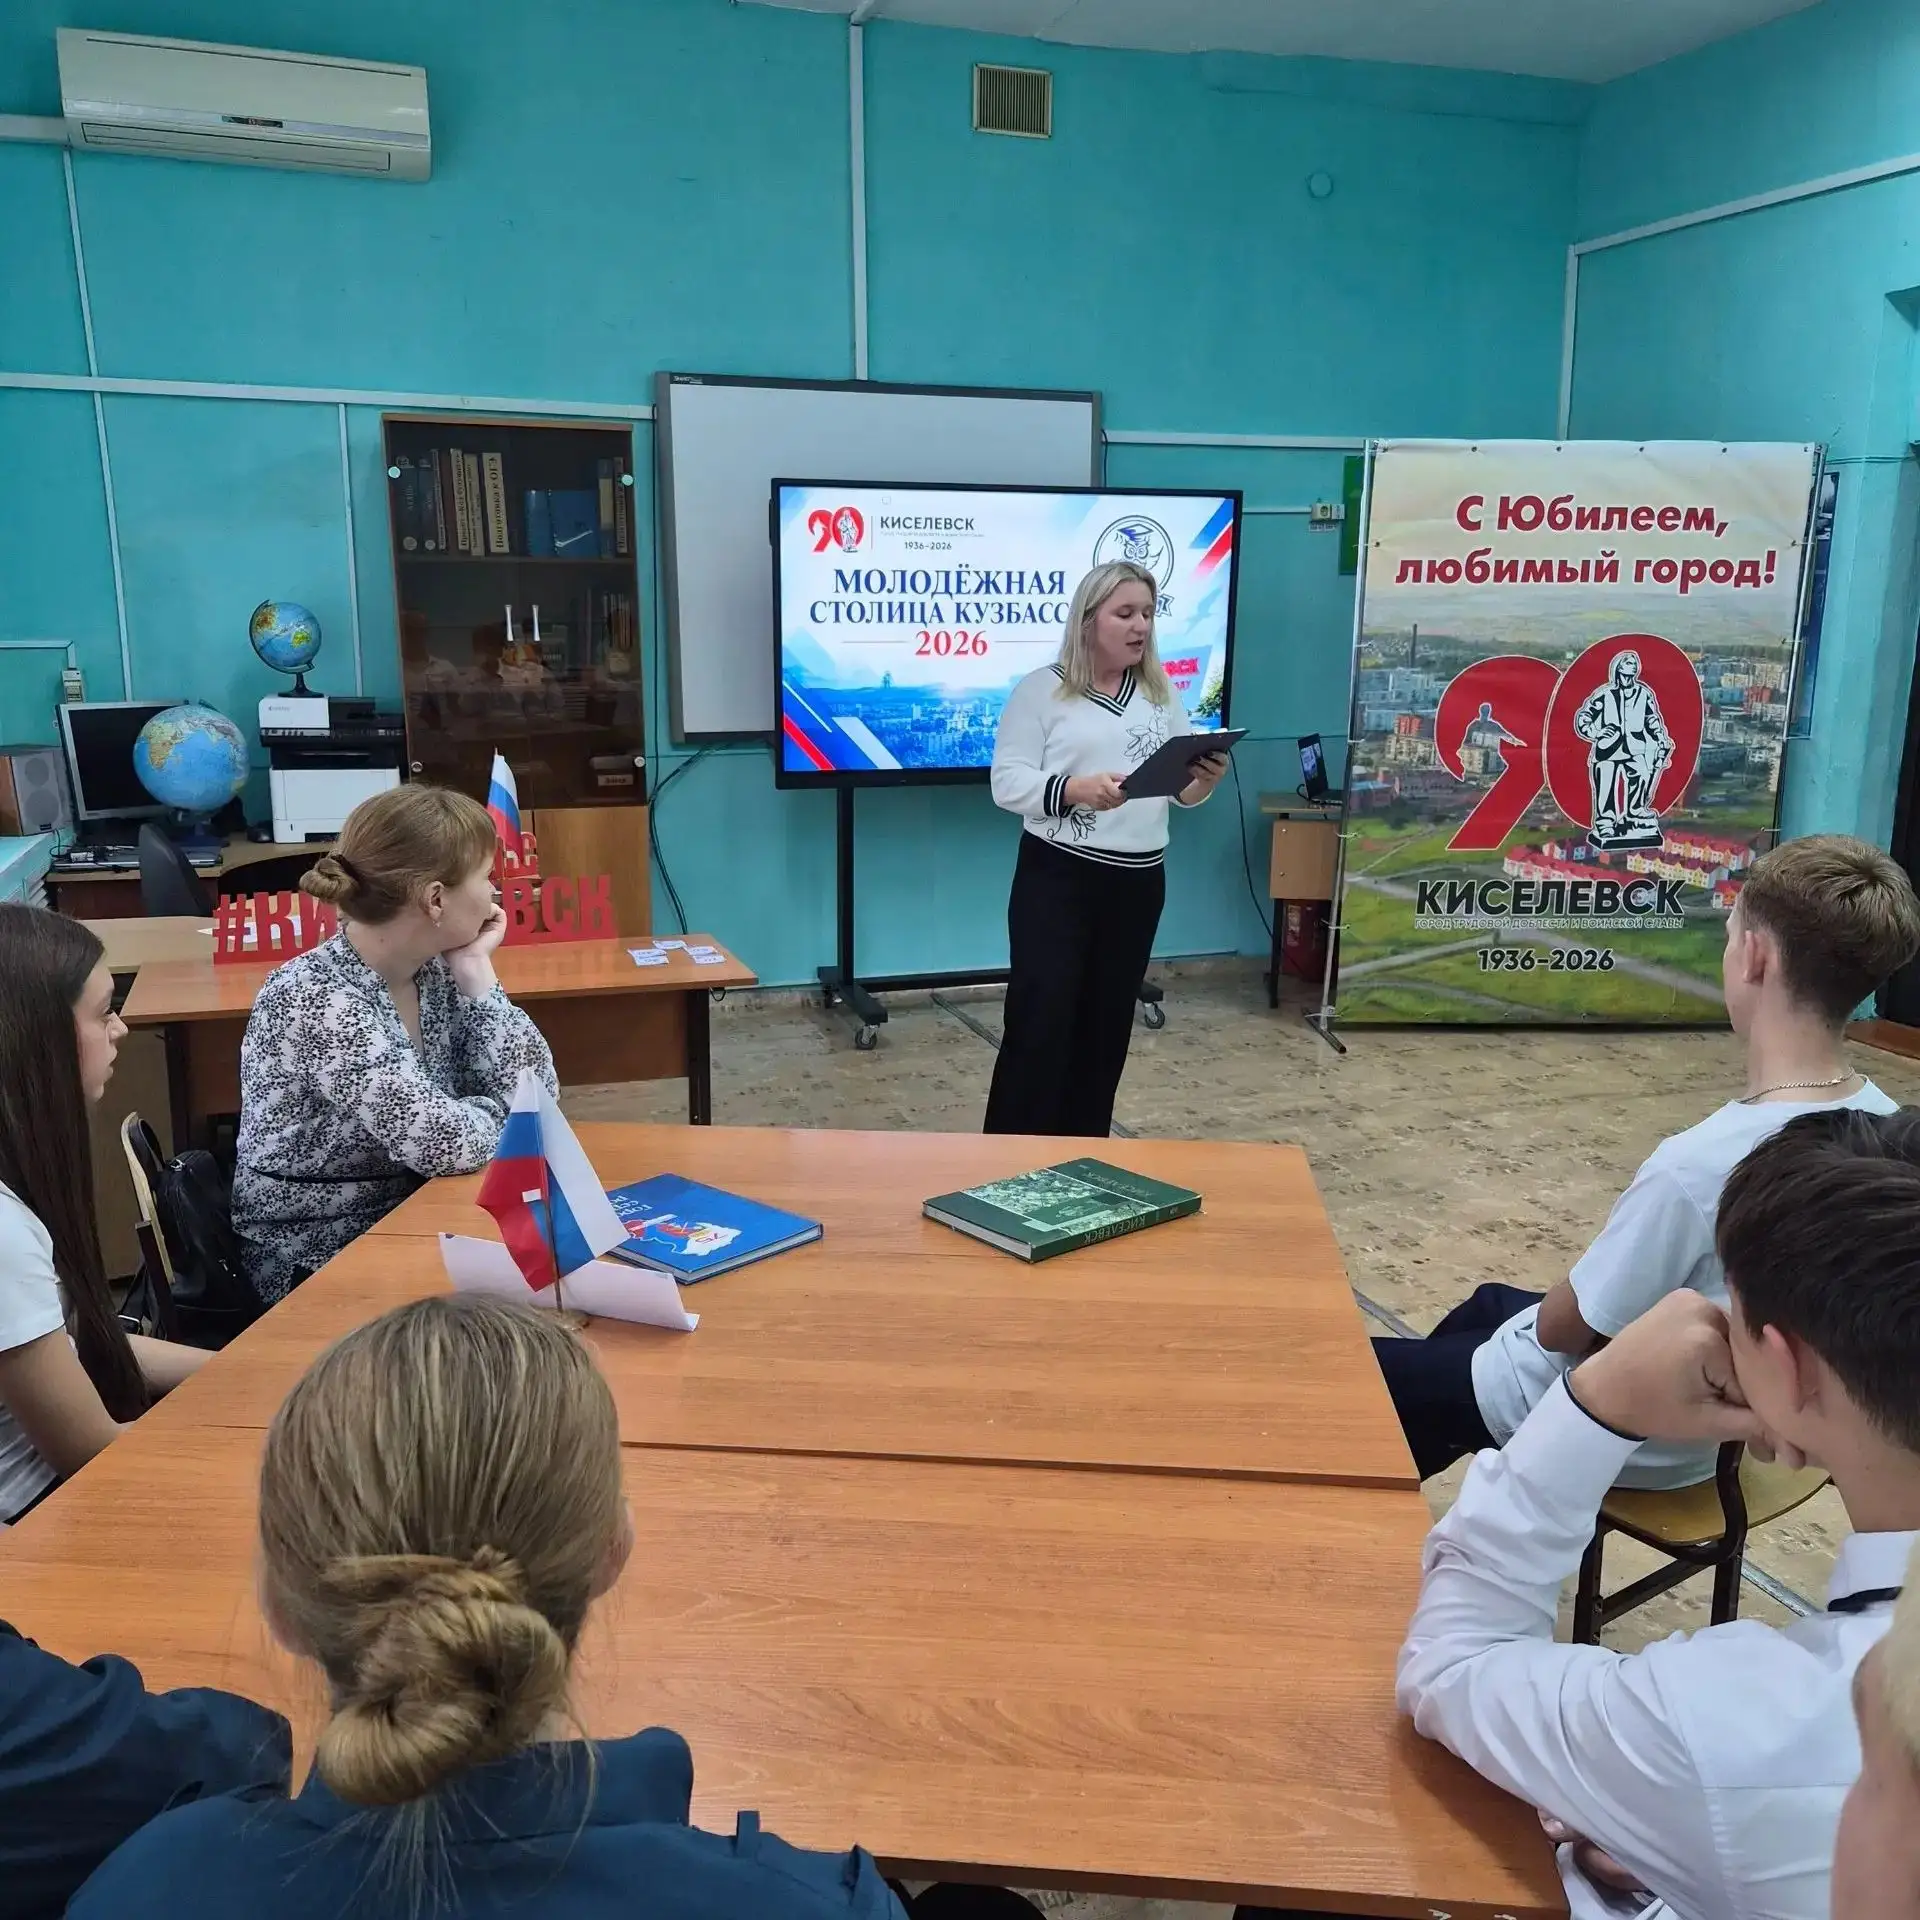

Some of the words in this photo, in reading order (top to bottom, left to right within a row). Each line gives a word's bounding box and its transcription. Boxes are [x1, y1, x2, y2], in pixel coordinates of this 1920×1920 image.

[880, 516, 975, 531] КИСЕЛЕВСК
[1456, 495, 1484, 532] С
[1497, 494, 1729, 538] Юбилеем,
[904, 541, 952, 551] 1936-2026
[833, 563, 1066, 600] МОЛОДЁЖНАЯ
[1396, 547, 1619, 584] любимый
[1634, 549, 1777, 595] город!
[810, 600, 945, 628] СТОЛИЦА
[955, 602, 1070, 624] КУЗБАСС
[915, 630, 988, 656] 2026
[1415, 879, 1686, 916] КИСЕЛЕВСК
[1415, 917, 1451, 929] ГОРОД
[1453, 916, 1510, 929] ТРУДОВОЙ
[1512, 917, 1569, 929] ДОБЛЕСТИ
[1571, 918, 1580, 928] И
[1581, 916, 1643, 929] ВОИНСКОЙ
[1645, 917, 1685, 929] СЛАВЫ
[1477, 948, 1616, 971] 1936-2026
